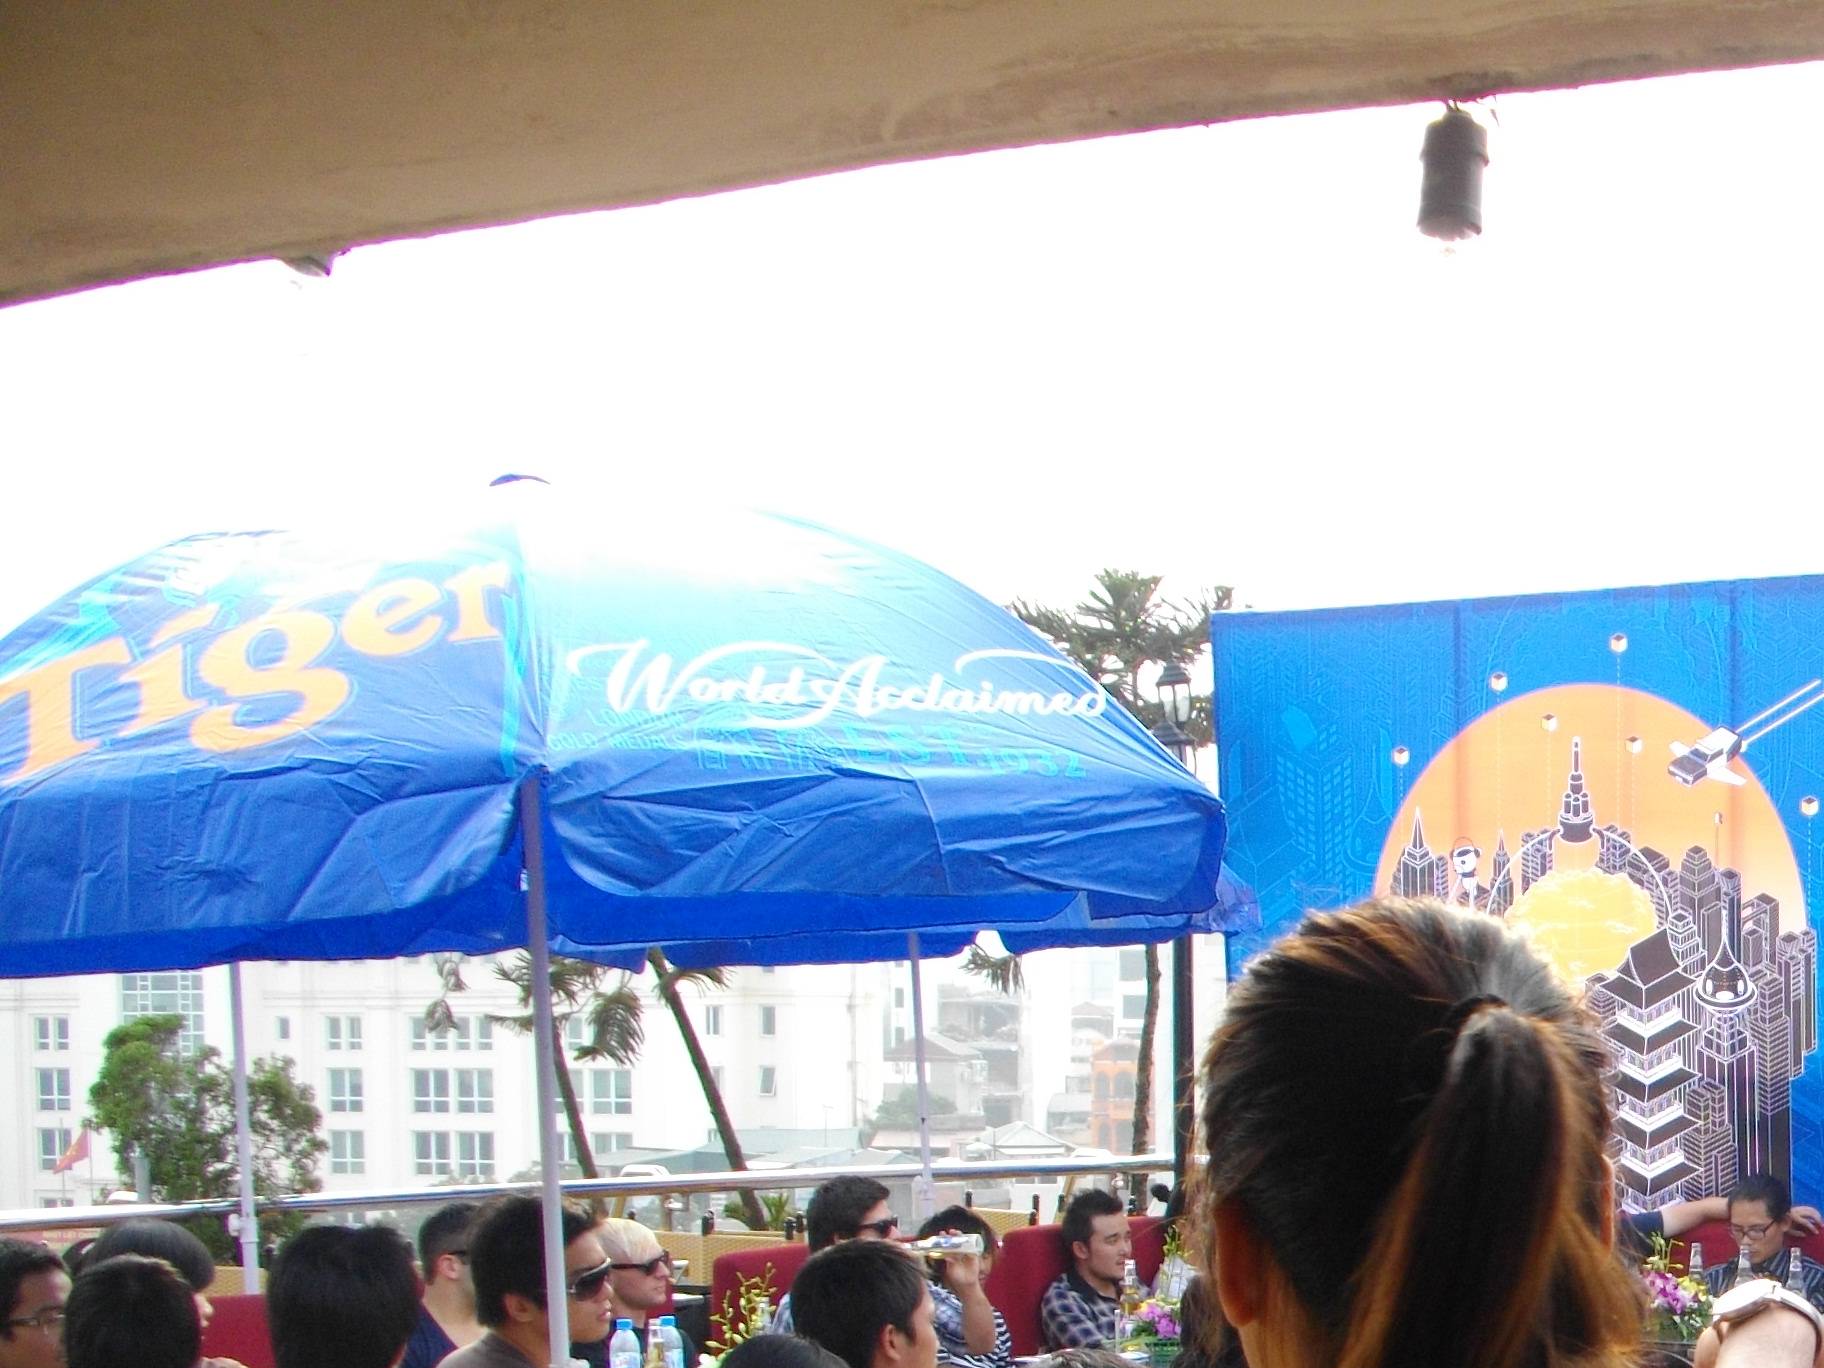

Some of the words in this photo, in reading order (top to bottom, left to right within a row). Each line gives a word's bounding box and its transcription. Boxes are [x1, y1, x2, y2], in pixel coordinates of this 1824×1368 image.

[0, 561, 510, 782] Tiger
[567, 638, 838, 714] World
[735, 647, 1107, 728] Acclaimed
